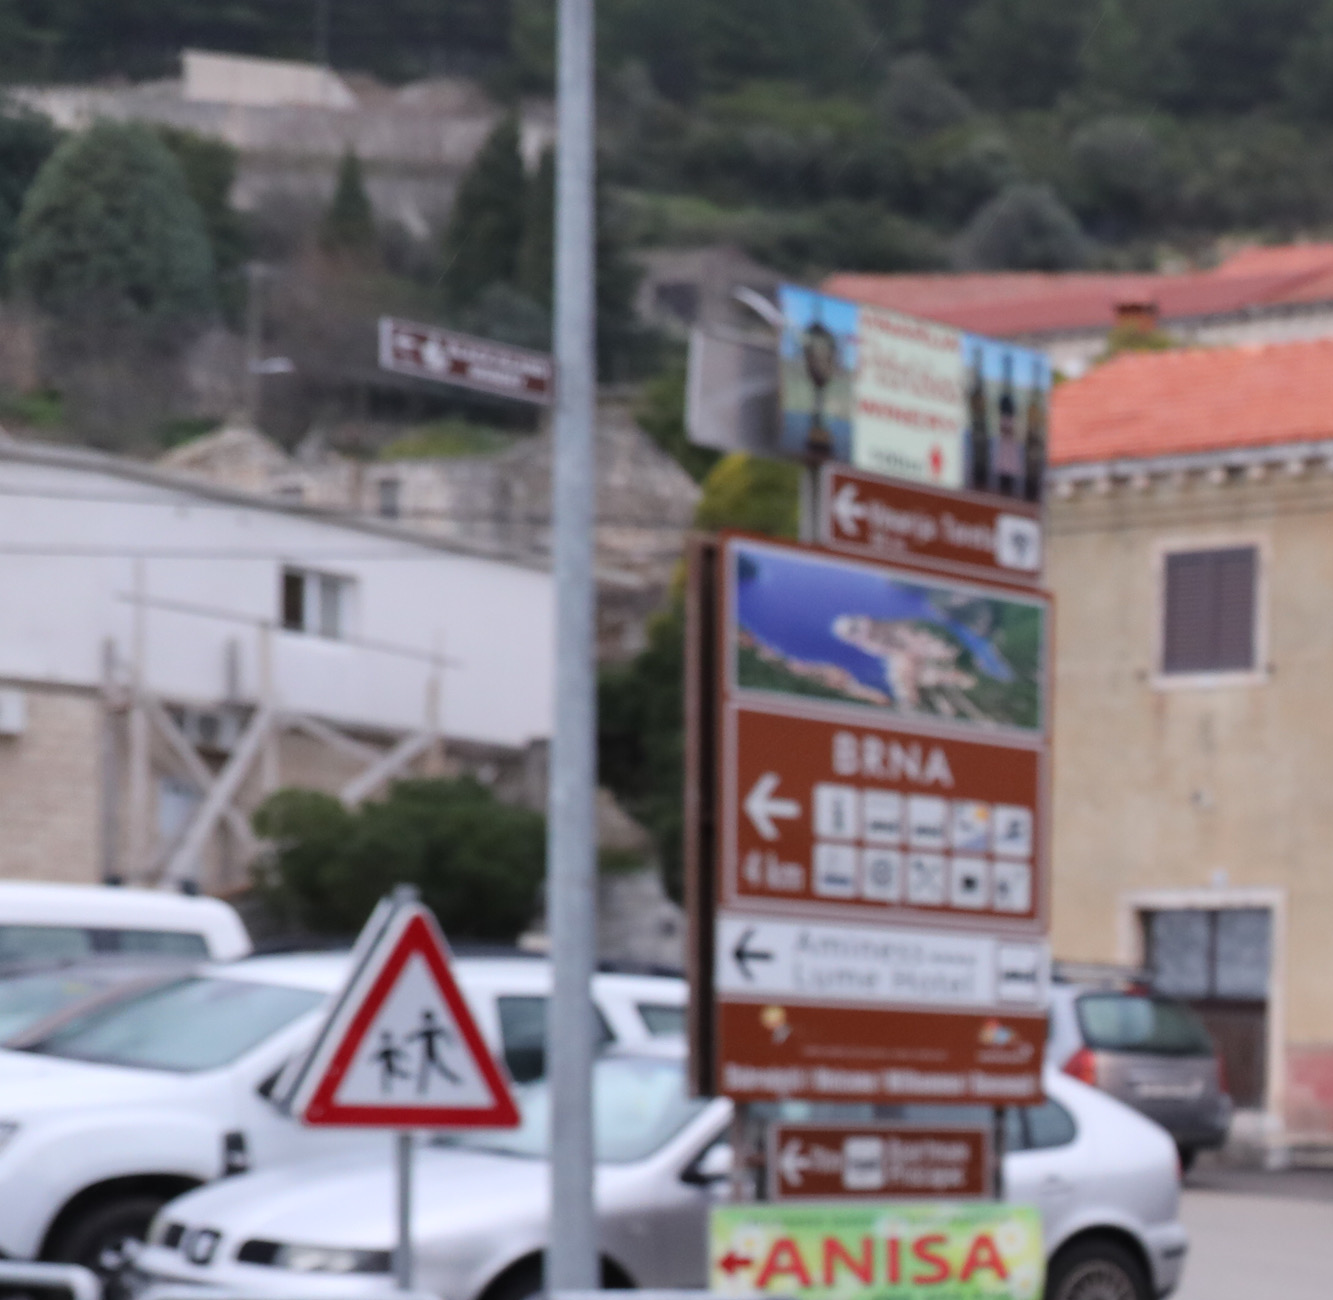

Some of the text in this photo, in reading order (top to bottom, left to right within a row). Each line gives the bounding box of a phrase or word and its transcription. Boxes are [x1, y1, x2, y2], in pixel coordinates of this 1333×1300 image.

[831, 730, 954, 788] BRNA
[893, 965, 976, 994] Hotel
[755, 1233, 1009, 1289] ANISA
